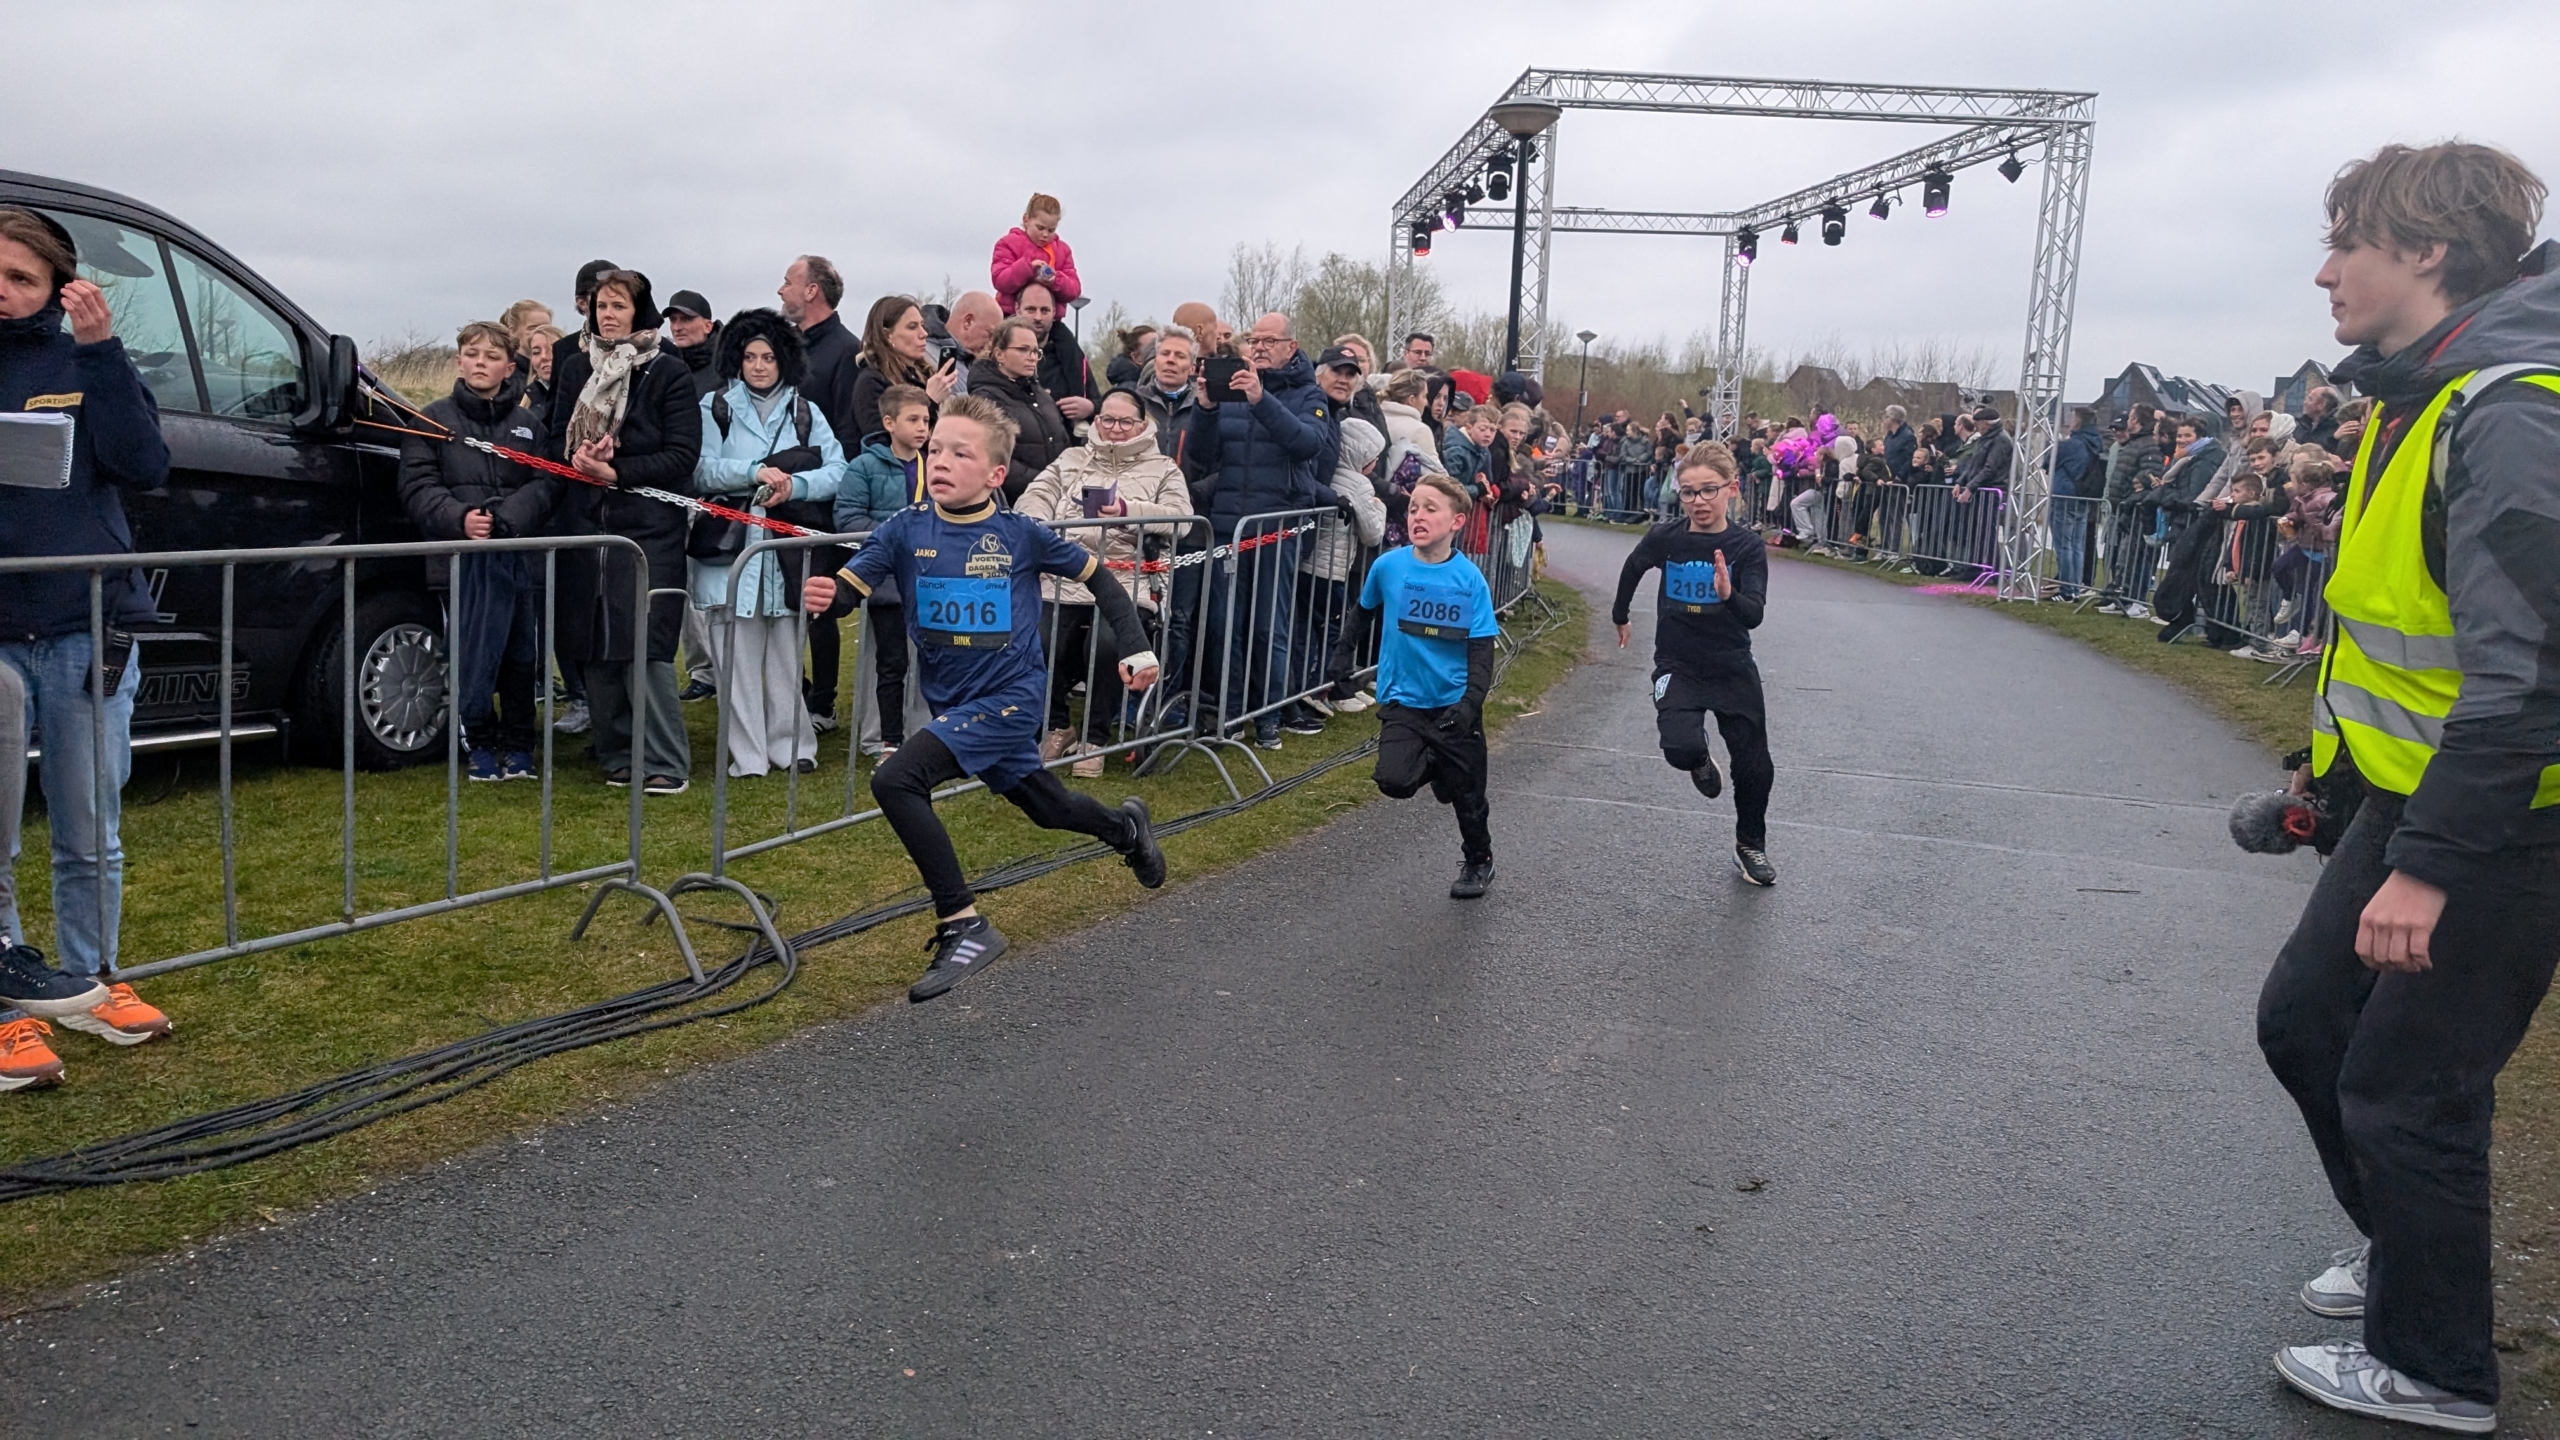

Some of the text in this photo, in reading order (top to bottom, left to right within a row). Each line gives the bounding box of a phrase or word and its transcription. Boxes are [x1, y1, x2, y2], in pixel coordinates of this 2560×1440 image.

[28, 394, 81, 408] SPORTRENT
[914, 548, 937, 557] JAKO
[968, 564, 997, 572] DAGEN
[1673, 579, 1718, 598] 2185
[929, 600, 996, 625] 2016
[1408, 599, 1461, 622] 2086
[1424, 626, 1439, 636] FINN
[953, 635, 971, 646] BINK
